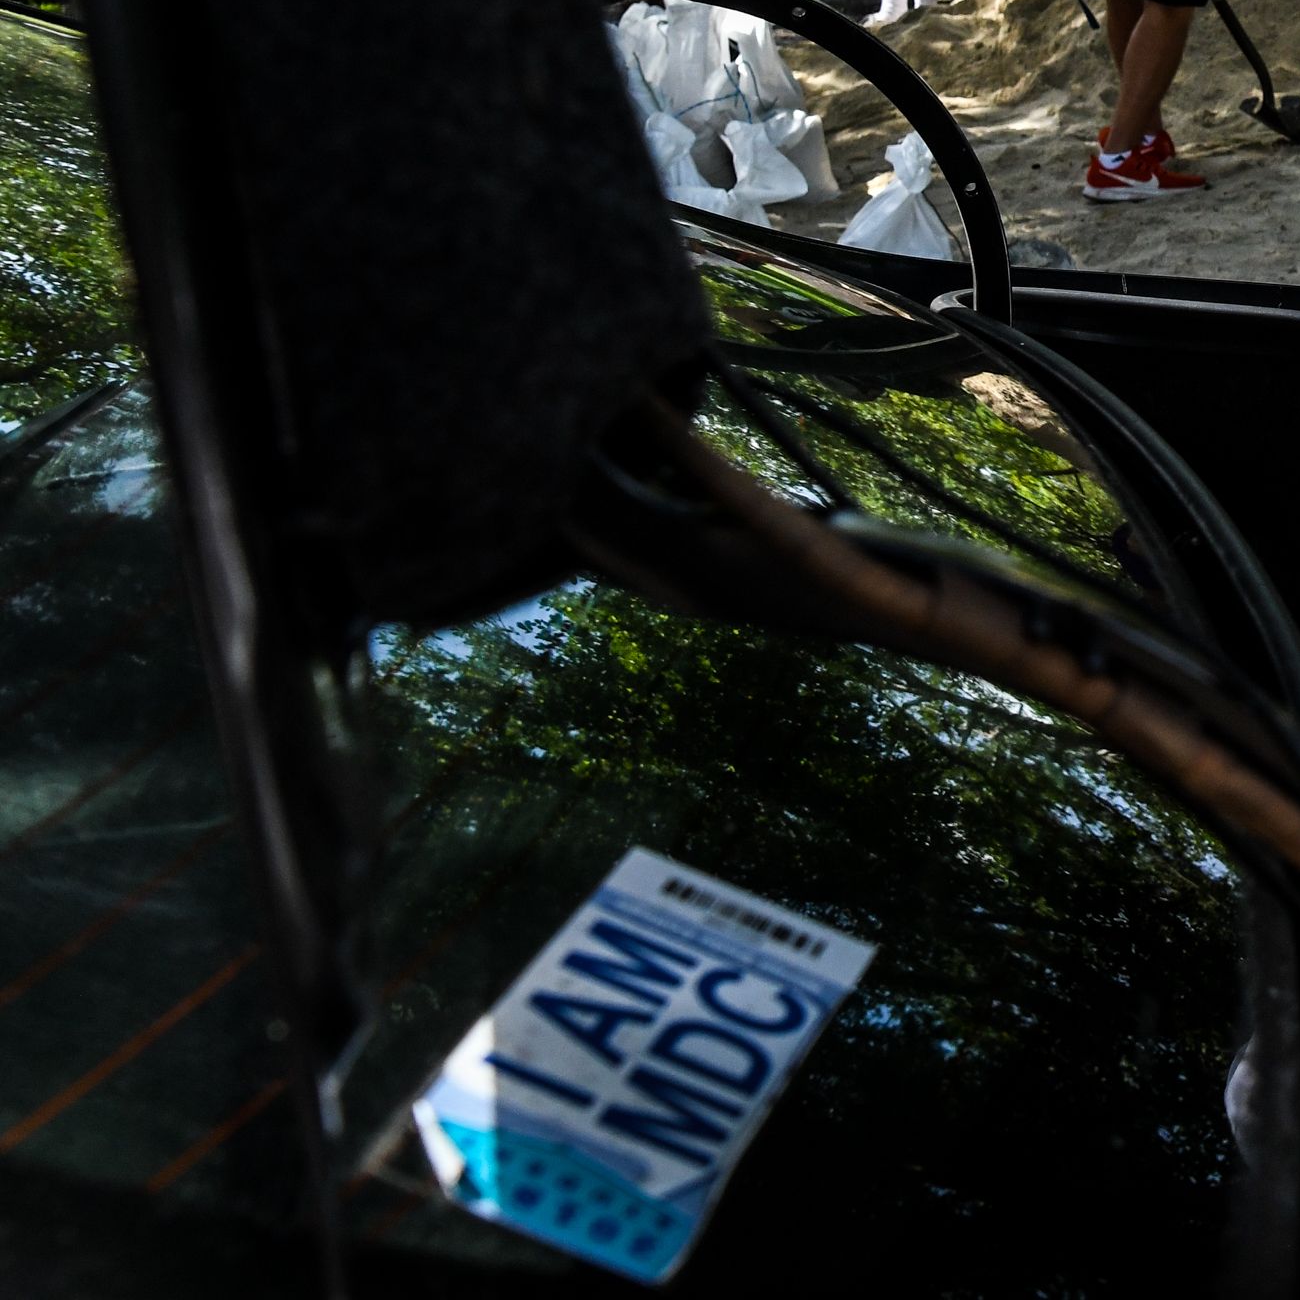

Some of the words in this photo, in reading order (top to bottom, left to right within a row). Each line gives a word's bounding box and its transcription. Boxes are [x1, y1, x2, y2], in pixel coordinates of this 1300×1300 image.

[529, 919, 699, 1069] AM
[597, 967, 809, 1168] MDC
[483, 1053, 597, 1109] I
